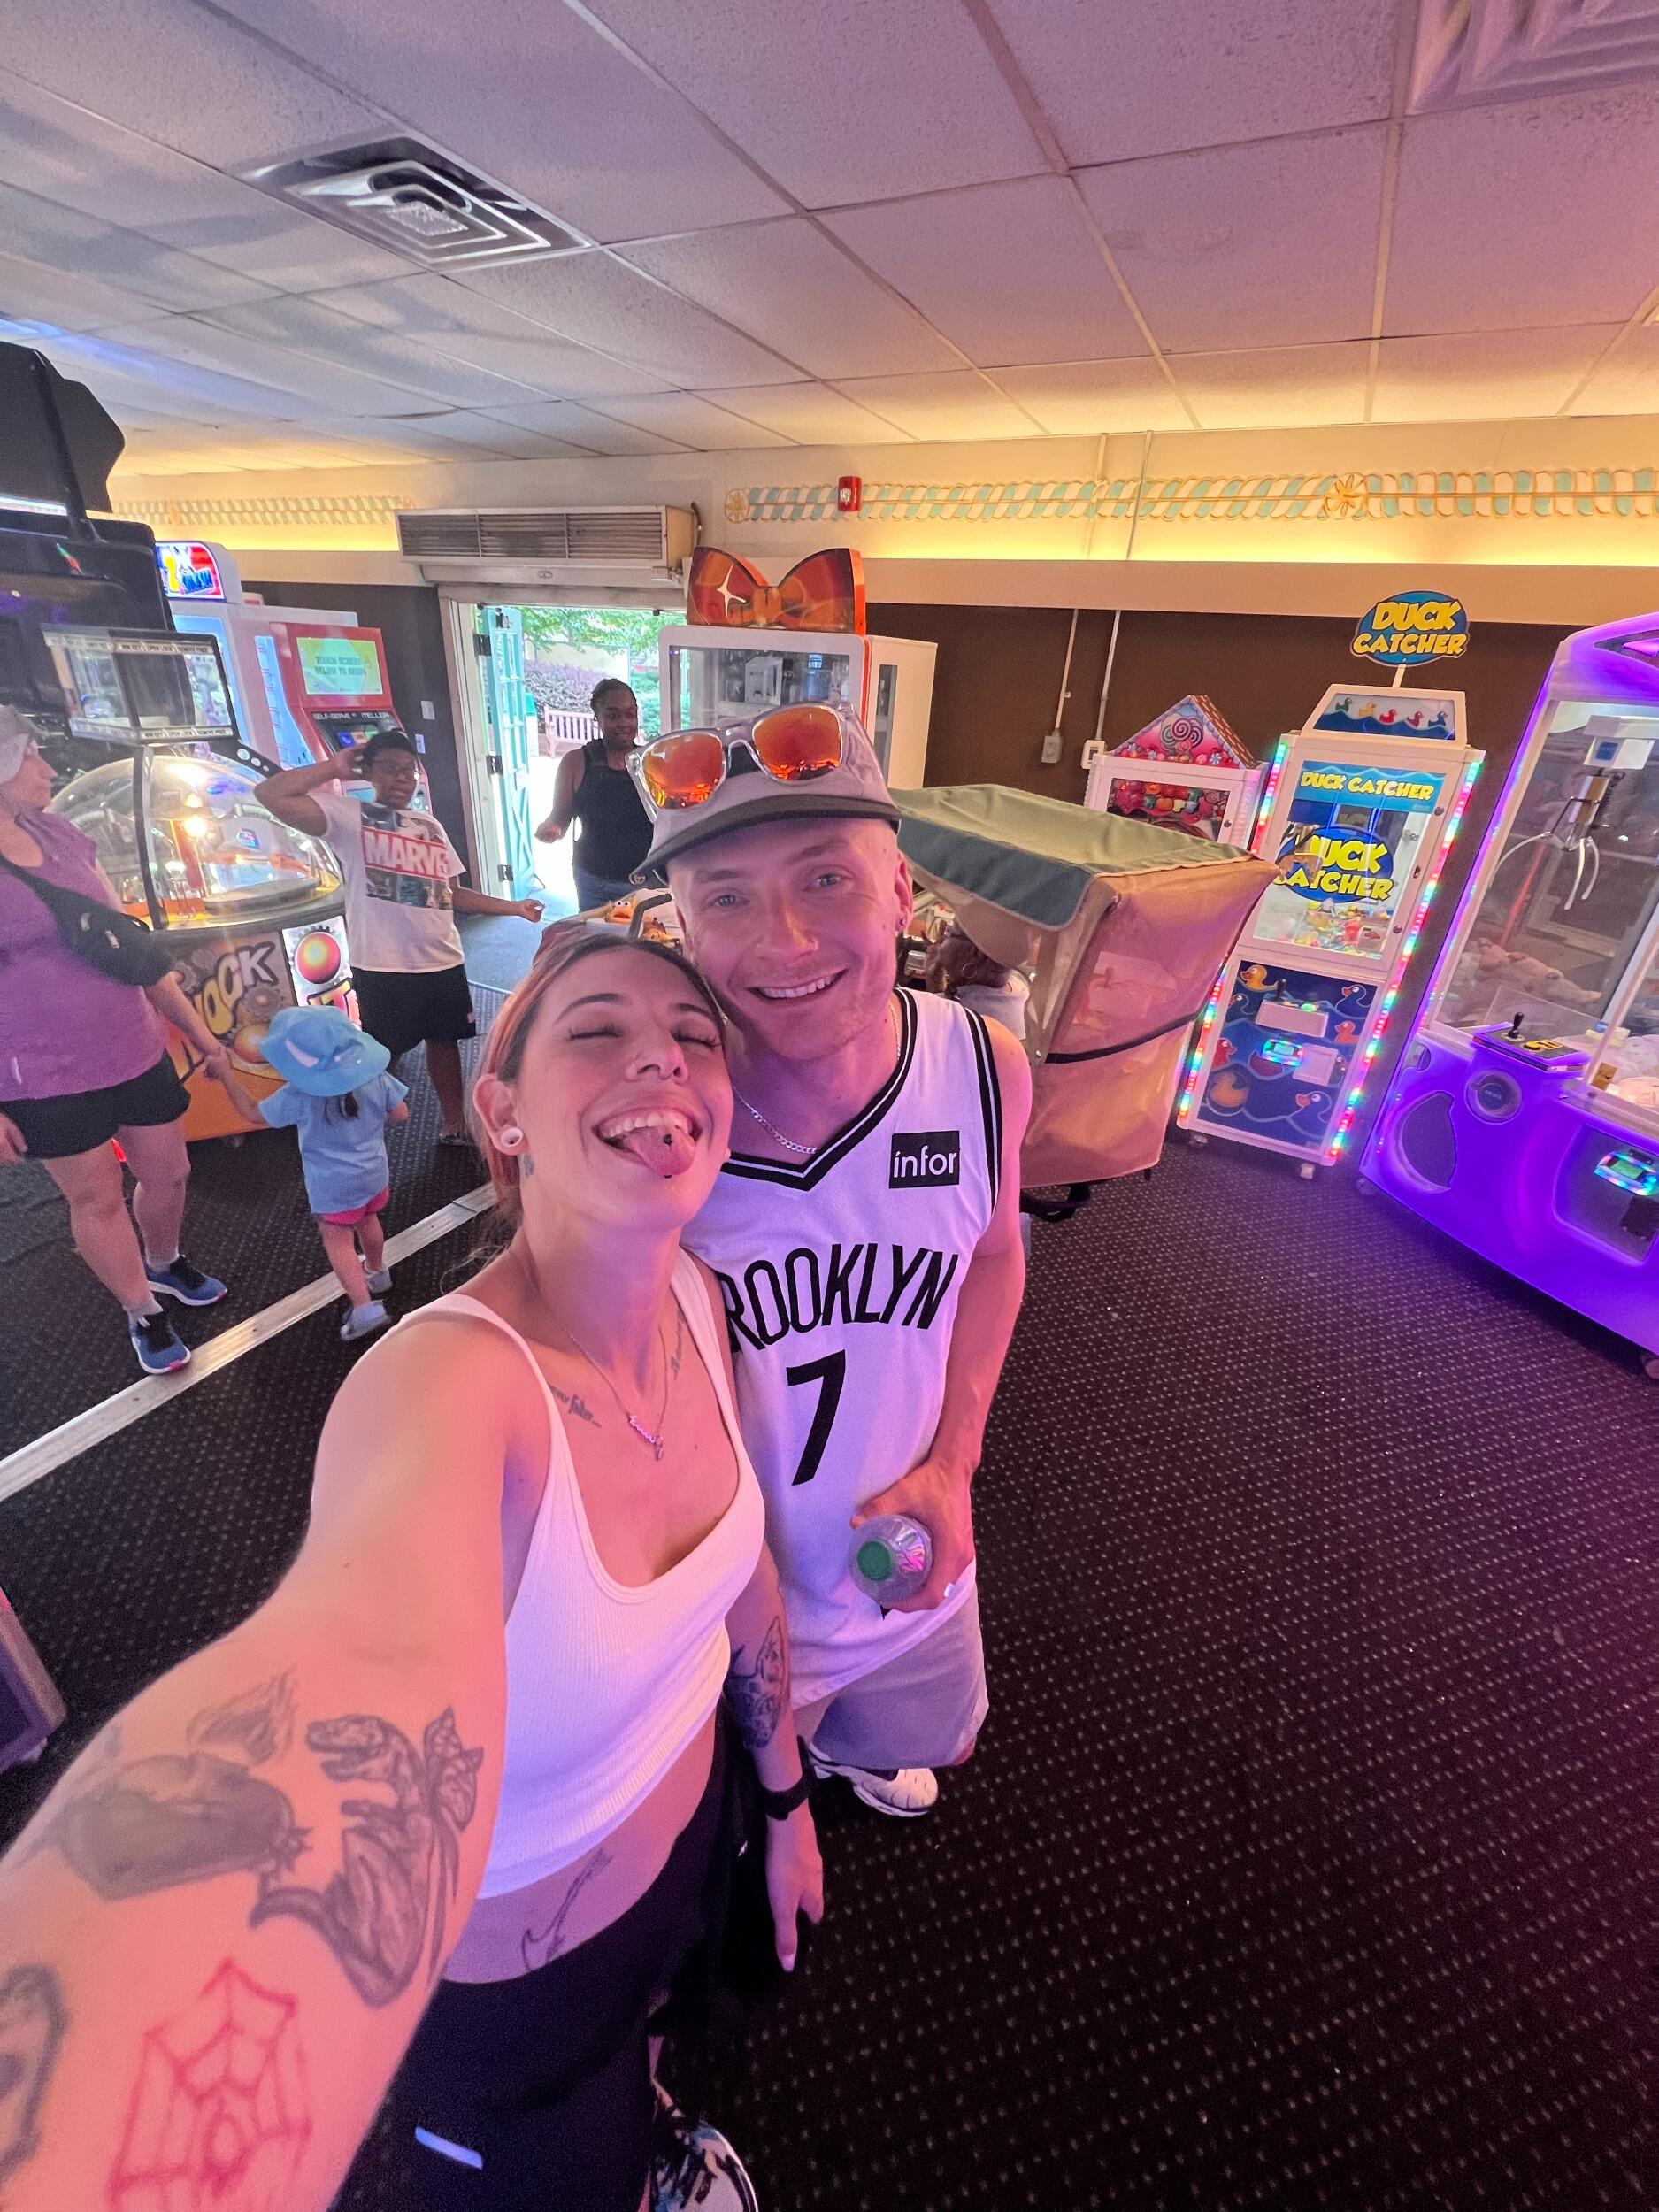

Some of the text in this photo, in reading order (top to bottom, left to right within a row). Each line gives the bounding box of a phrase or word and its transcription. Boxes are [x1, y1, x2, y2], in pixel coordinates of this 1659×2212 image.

[1372, 601, 1462, 631] DUCK
[1353, 633, 1467, 655] CATCHER
[1300, 772, 1434, 800] DUCK CATCHER
[1273, 867, 1394, 901] ATCHER
[194, 945, 275, 1035] OCK
[893, 1145, 957, 1178] infor
[786, 1348, 847, 1486] 7
